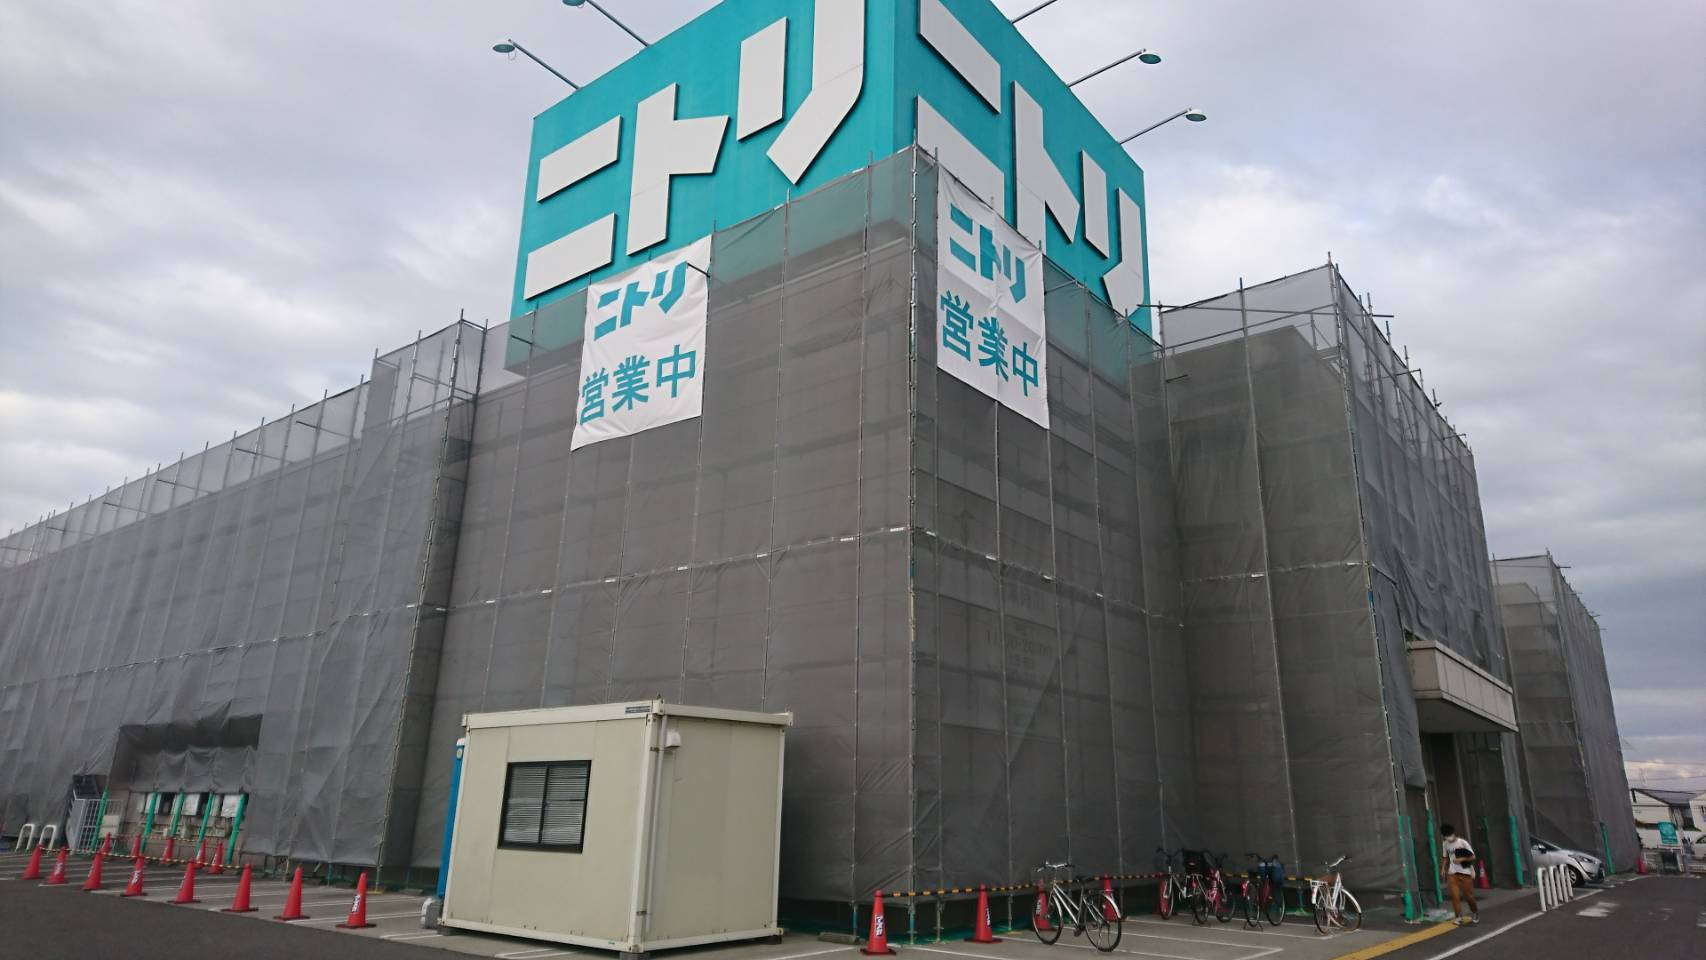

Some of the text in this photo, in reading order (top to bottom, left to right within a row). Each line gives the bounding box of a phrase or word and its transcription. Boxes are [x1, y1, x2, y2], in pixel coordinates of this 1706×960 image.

[524, 0, 866, 300] ニトリ
[917, 0, 1145, 318] ニトリ
[594, 261, 688, 341] ニトリ
[950, 203, 1027, 304] ニトリ
[579, 344, 697, 426] 営業中
[940, 290, 1039, 397] 営業中
